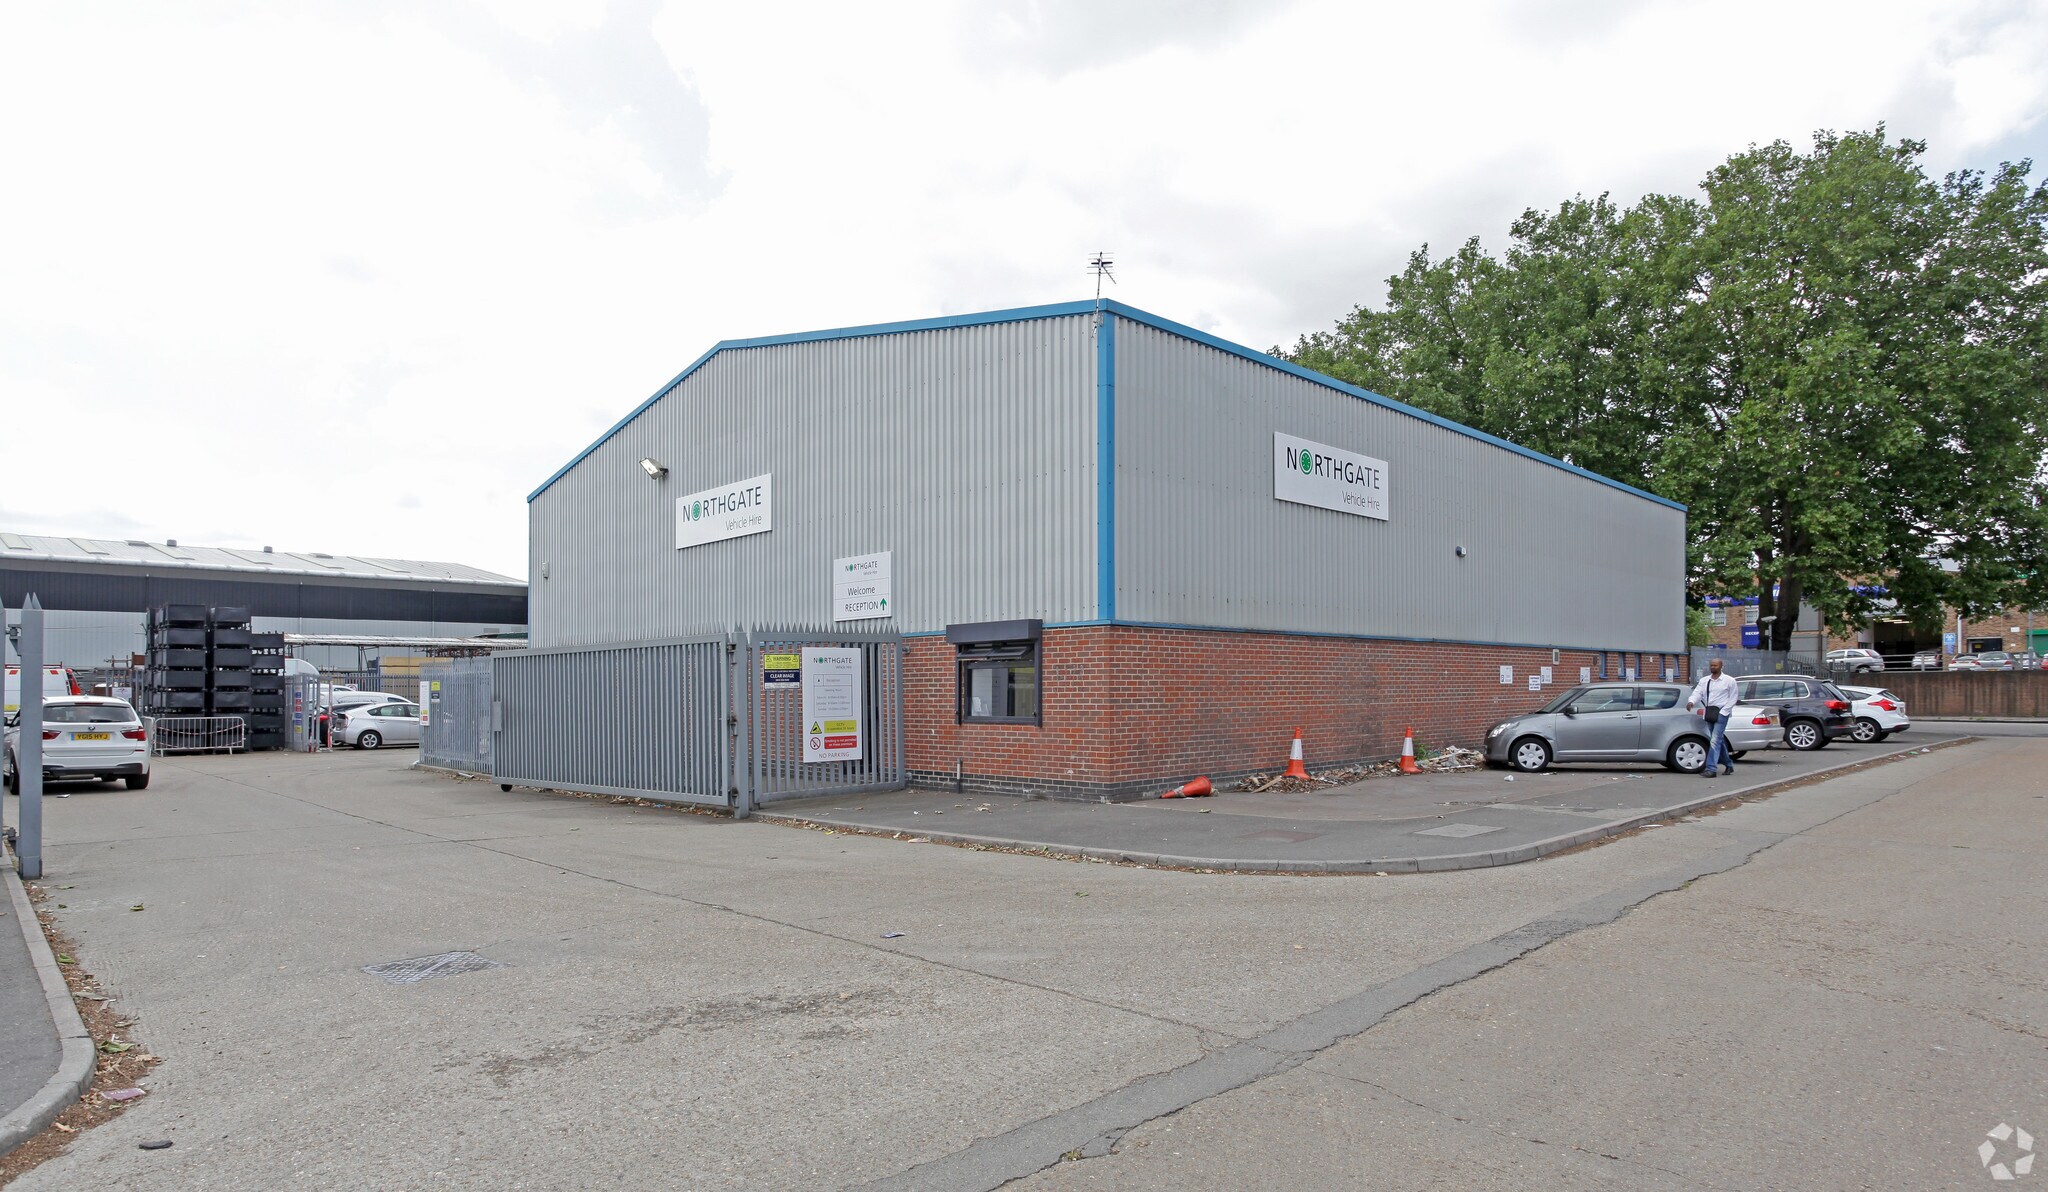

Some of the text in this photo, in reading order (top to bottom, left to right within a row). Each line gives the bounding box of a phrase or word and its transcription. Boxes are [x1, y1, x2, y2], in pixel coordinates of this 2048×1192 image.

[1287, 446, 1380, 490] NORTHGATE
[682, 486, 762, 523] NORTHGATE
[1342, 490, 1380, 511] Vehicle Hire
[726, 514, 762, 531] Vehicle Hire
[845, 561, 878, 572] NORTHGATE
[847, 586, 876, 596] Welcome
[845, 601, 879, 612] RECEPTION
